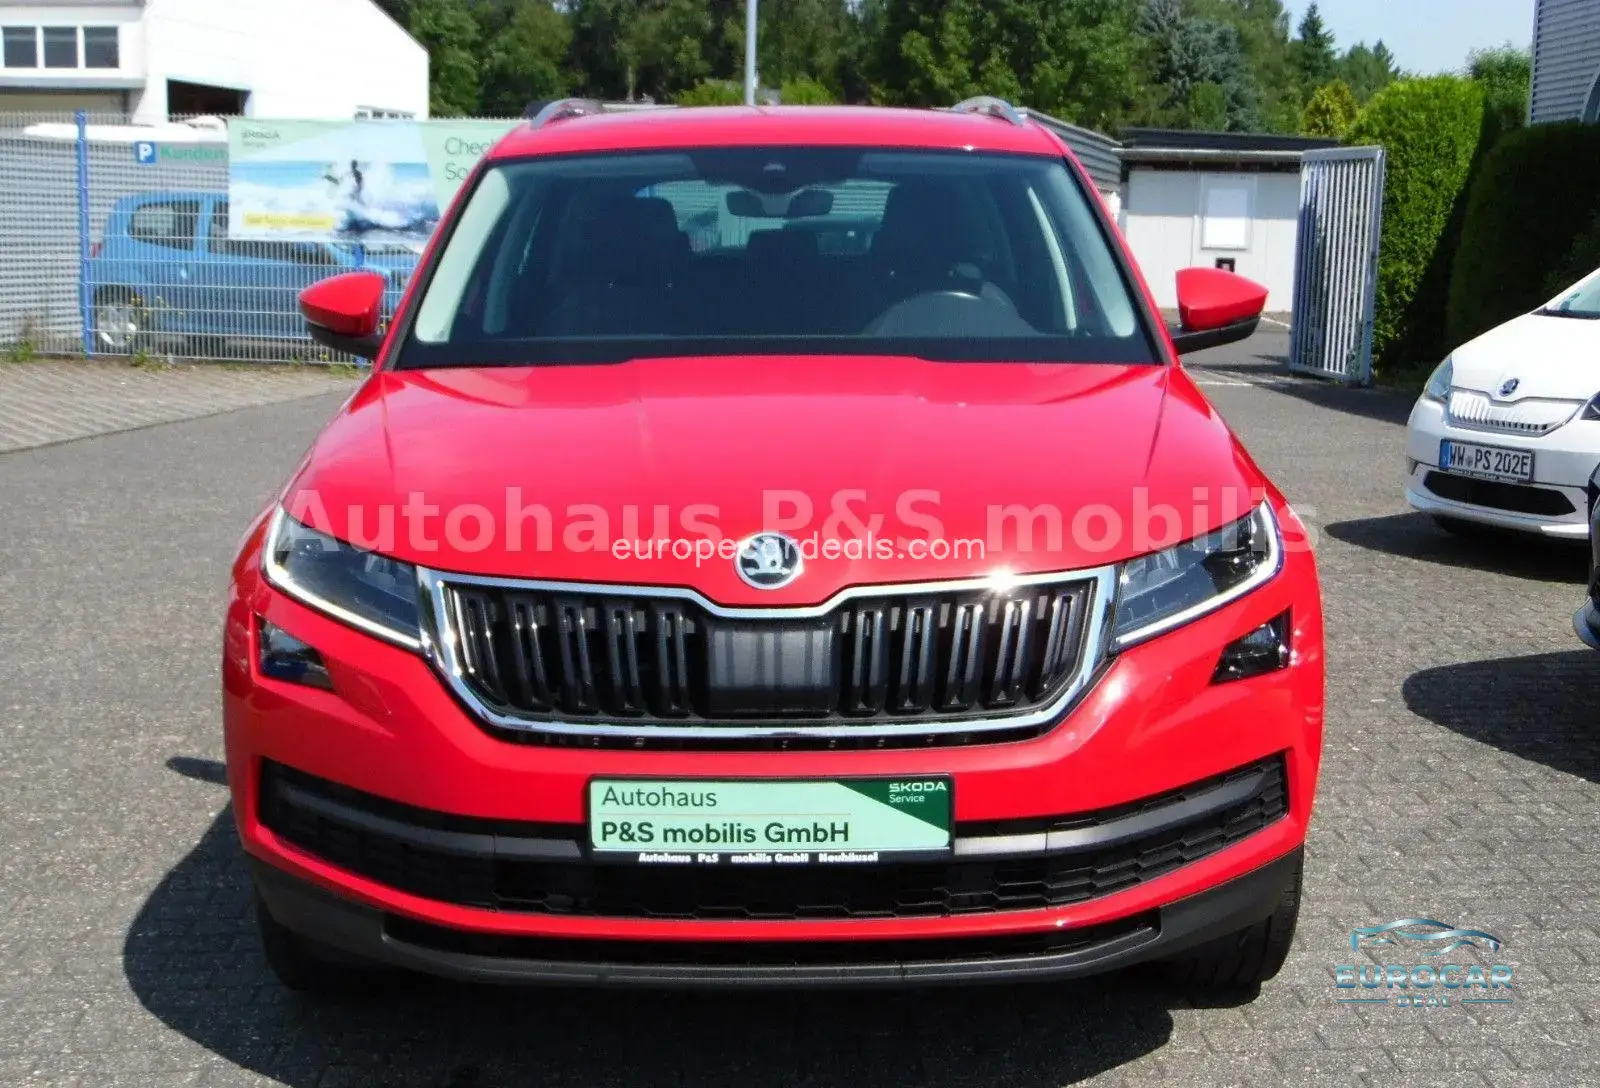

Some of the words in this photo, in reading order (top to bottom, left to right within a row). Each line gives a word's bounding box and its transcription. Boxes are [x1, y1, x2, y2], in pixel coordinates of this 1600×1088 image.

[445, 136, 494, 155] Chec
[445, 162, 471, 181] So
[1474, 448, 1491, 471] PS
[1494, 452, 1529, 475] 202E
[601, 786, 718, 807] Autohaus
[889, 794, 925, 803] Service
[601, 822, 655, 843] P&S
[662, 822, 757, 844] mobilis
[764, 821, 850, 843] GmbH
[638, 852, 692, 863] Autohaus
[731, 852, 772, 863] mobilis
[774, 852, 809, 863] GmbH
